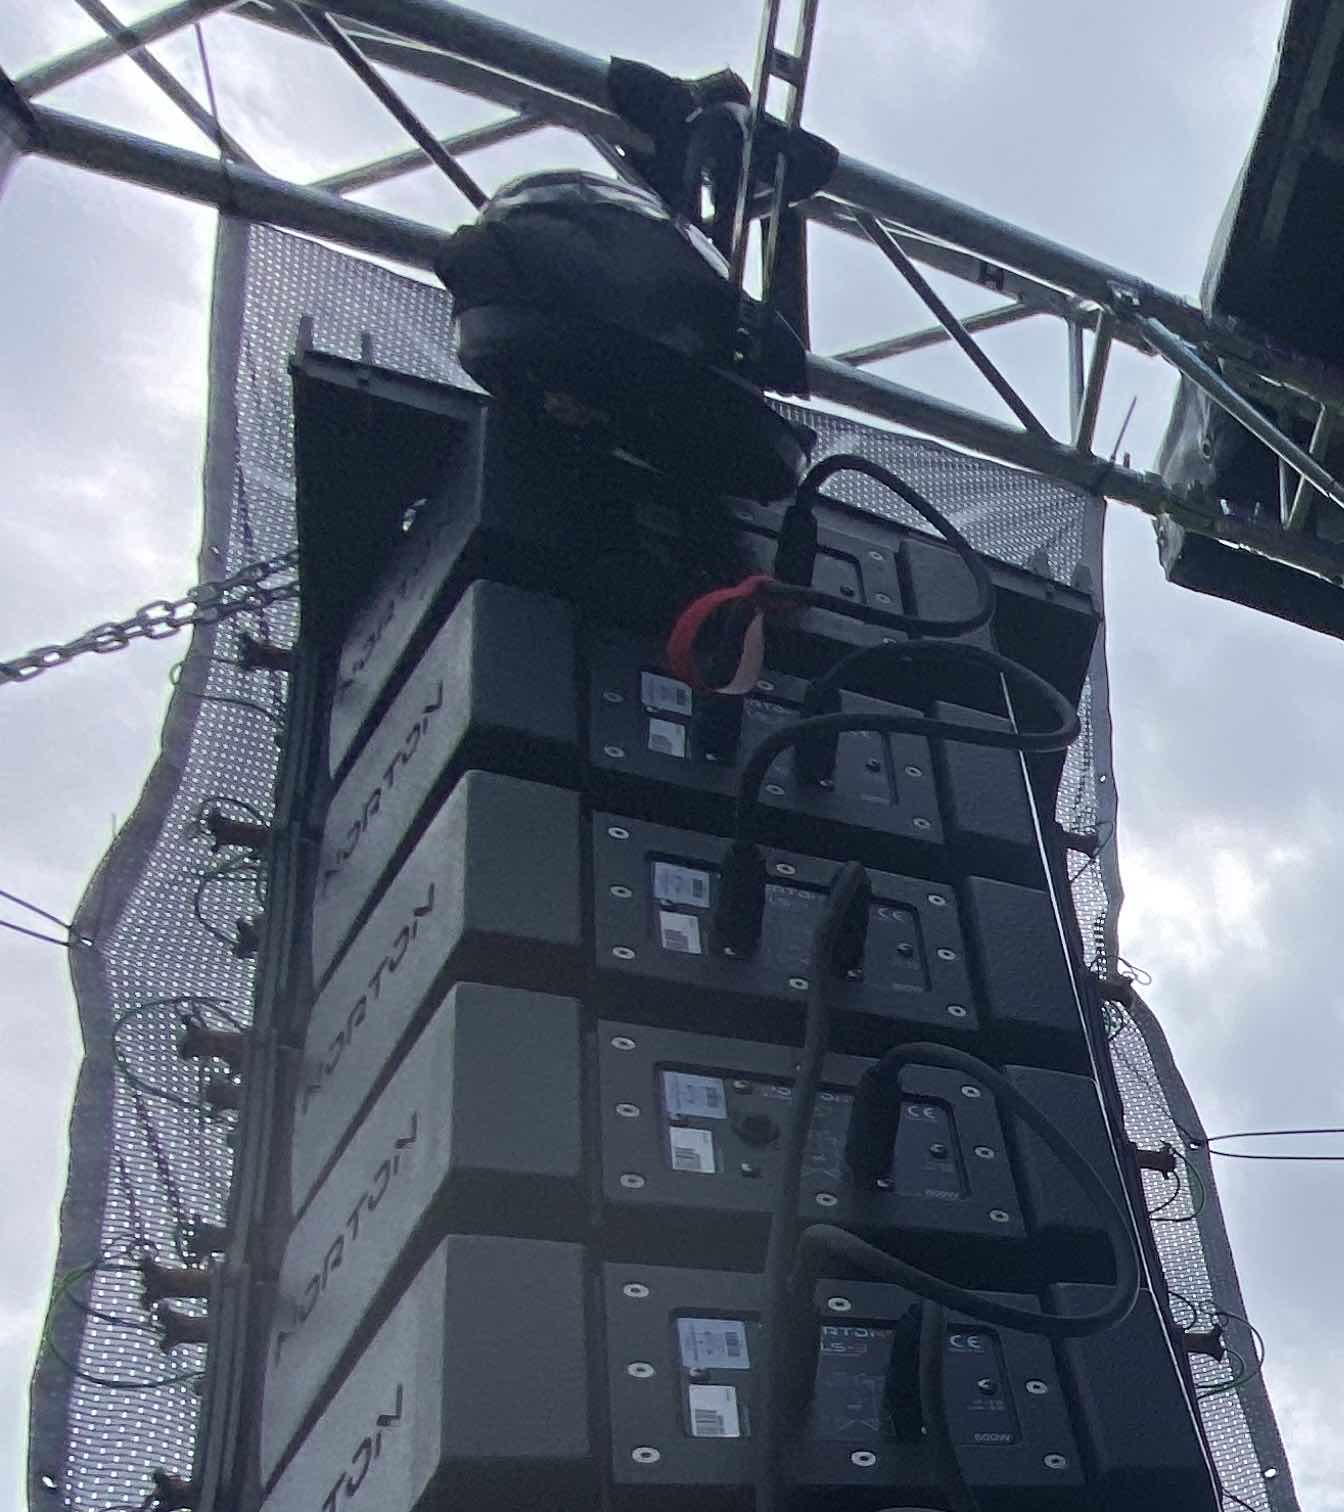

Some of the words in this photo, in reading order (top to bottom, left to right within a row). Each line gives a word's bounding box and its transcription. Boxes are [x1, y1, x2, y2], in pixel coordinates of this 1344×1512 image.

[321, 679, 444, 894] NORTON
[301, 882, 436, 1117] NORTON
[273, 1110, 418, 1366] NORTON
